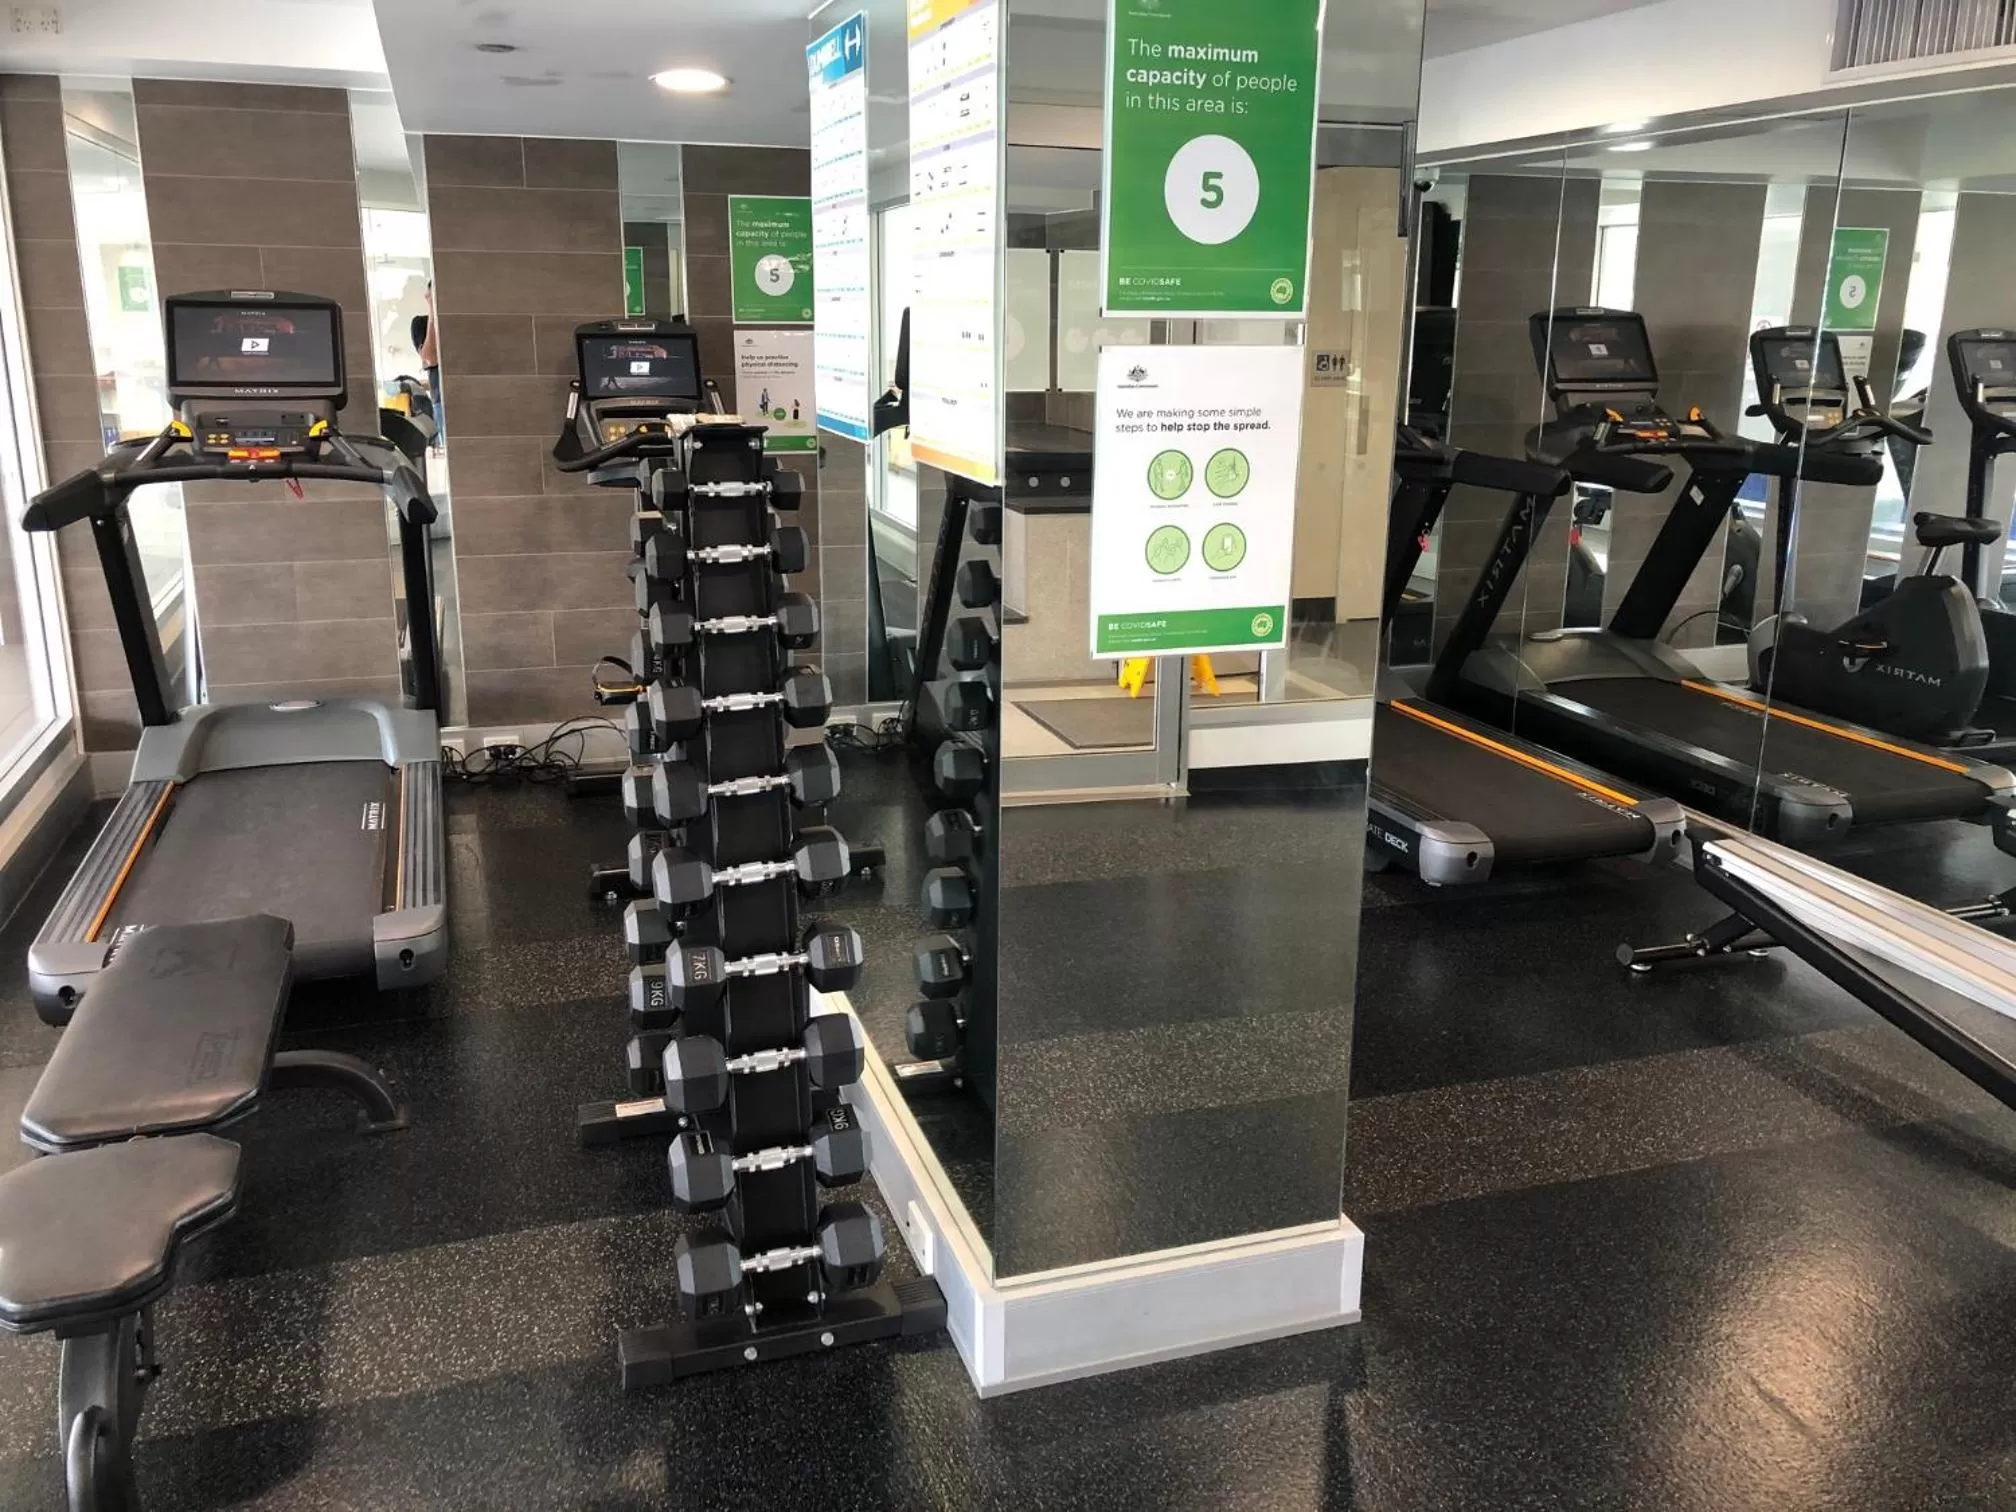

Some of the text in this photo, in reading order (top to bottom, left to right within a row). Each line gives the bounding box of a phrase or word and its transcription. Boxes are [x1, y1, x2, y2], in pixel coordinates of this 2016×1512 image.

[1128, 38, 1259, 64] The maximum
[1126, 67, 1298, 94] capacity of people
[1125, 92, 1249, 115] in this area is:
[1200, 171, 1224, 209] 5
[735, 230, 769, 238] capacity
[769, 267, 781, 283] 5
[1118, 277, 1131, 286] BE
[1116, 406, 1262, 419] We are making some simple
[1115, 420, 1271, 434] steps to help stop the spread.
[1108, 623, 1120, 631] BE
[366, 802, 380, 830] MATRIX
[1385, 831, 1409, 853] DECK
[691, 952, 708, 980] 7KG
[650, 980, 664, 1006] 9KG
